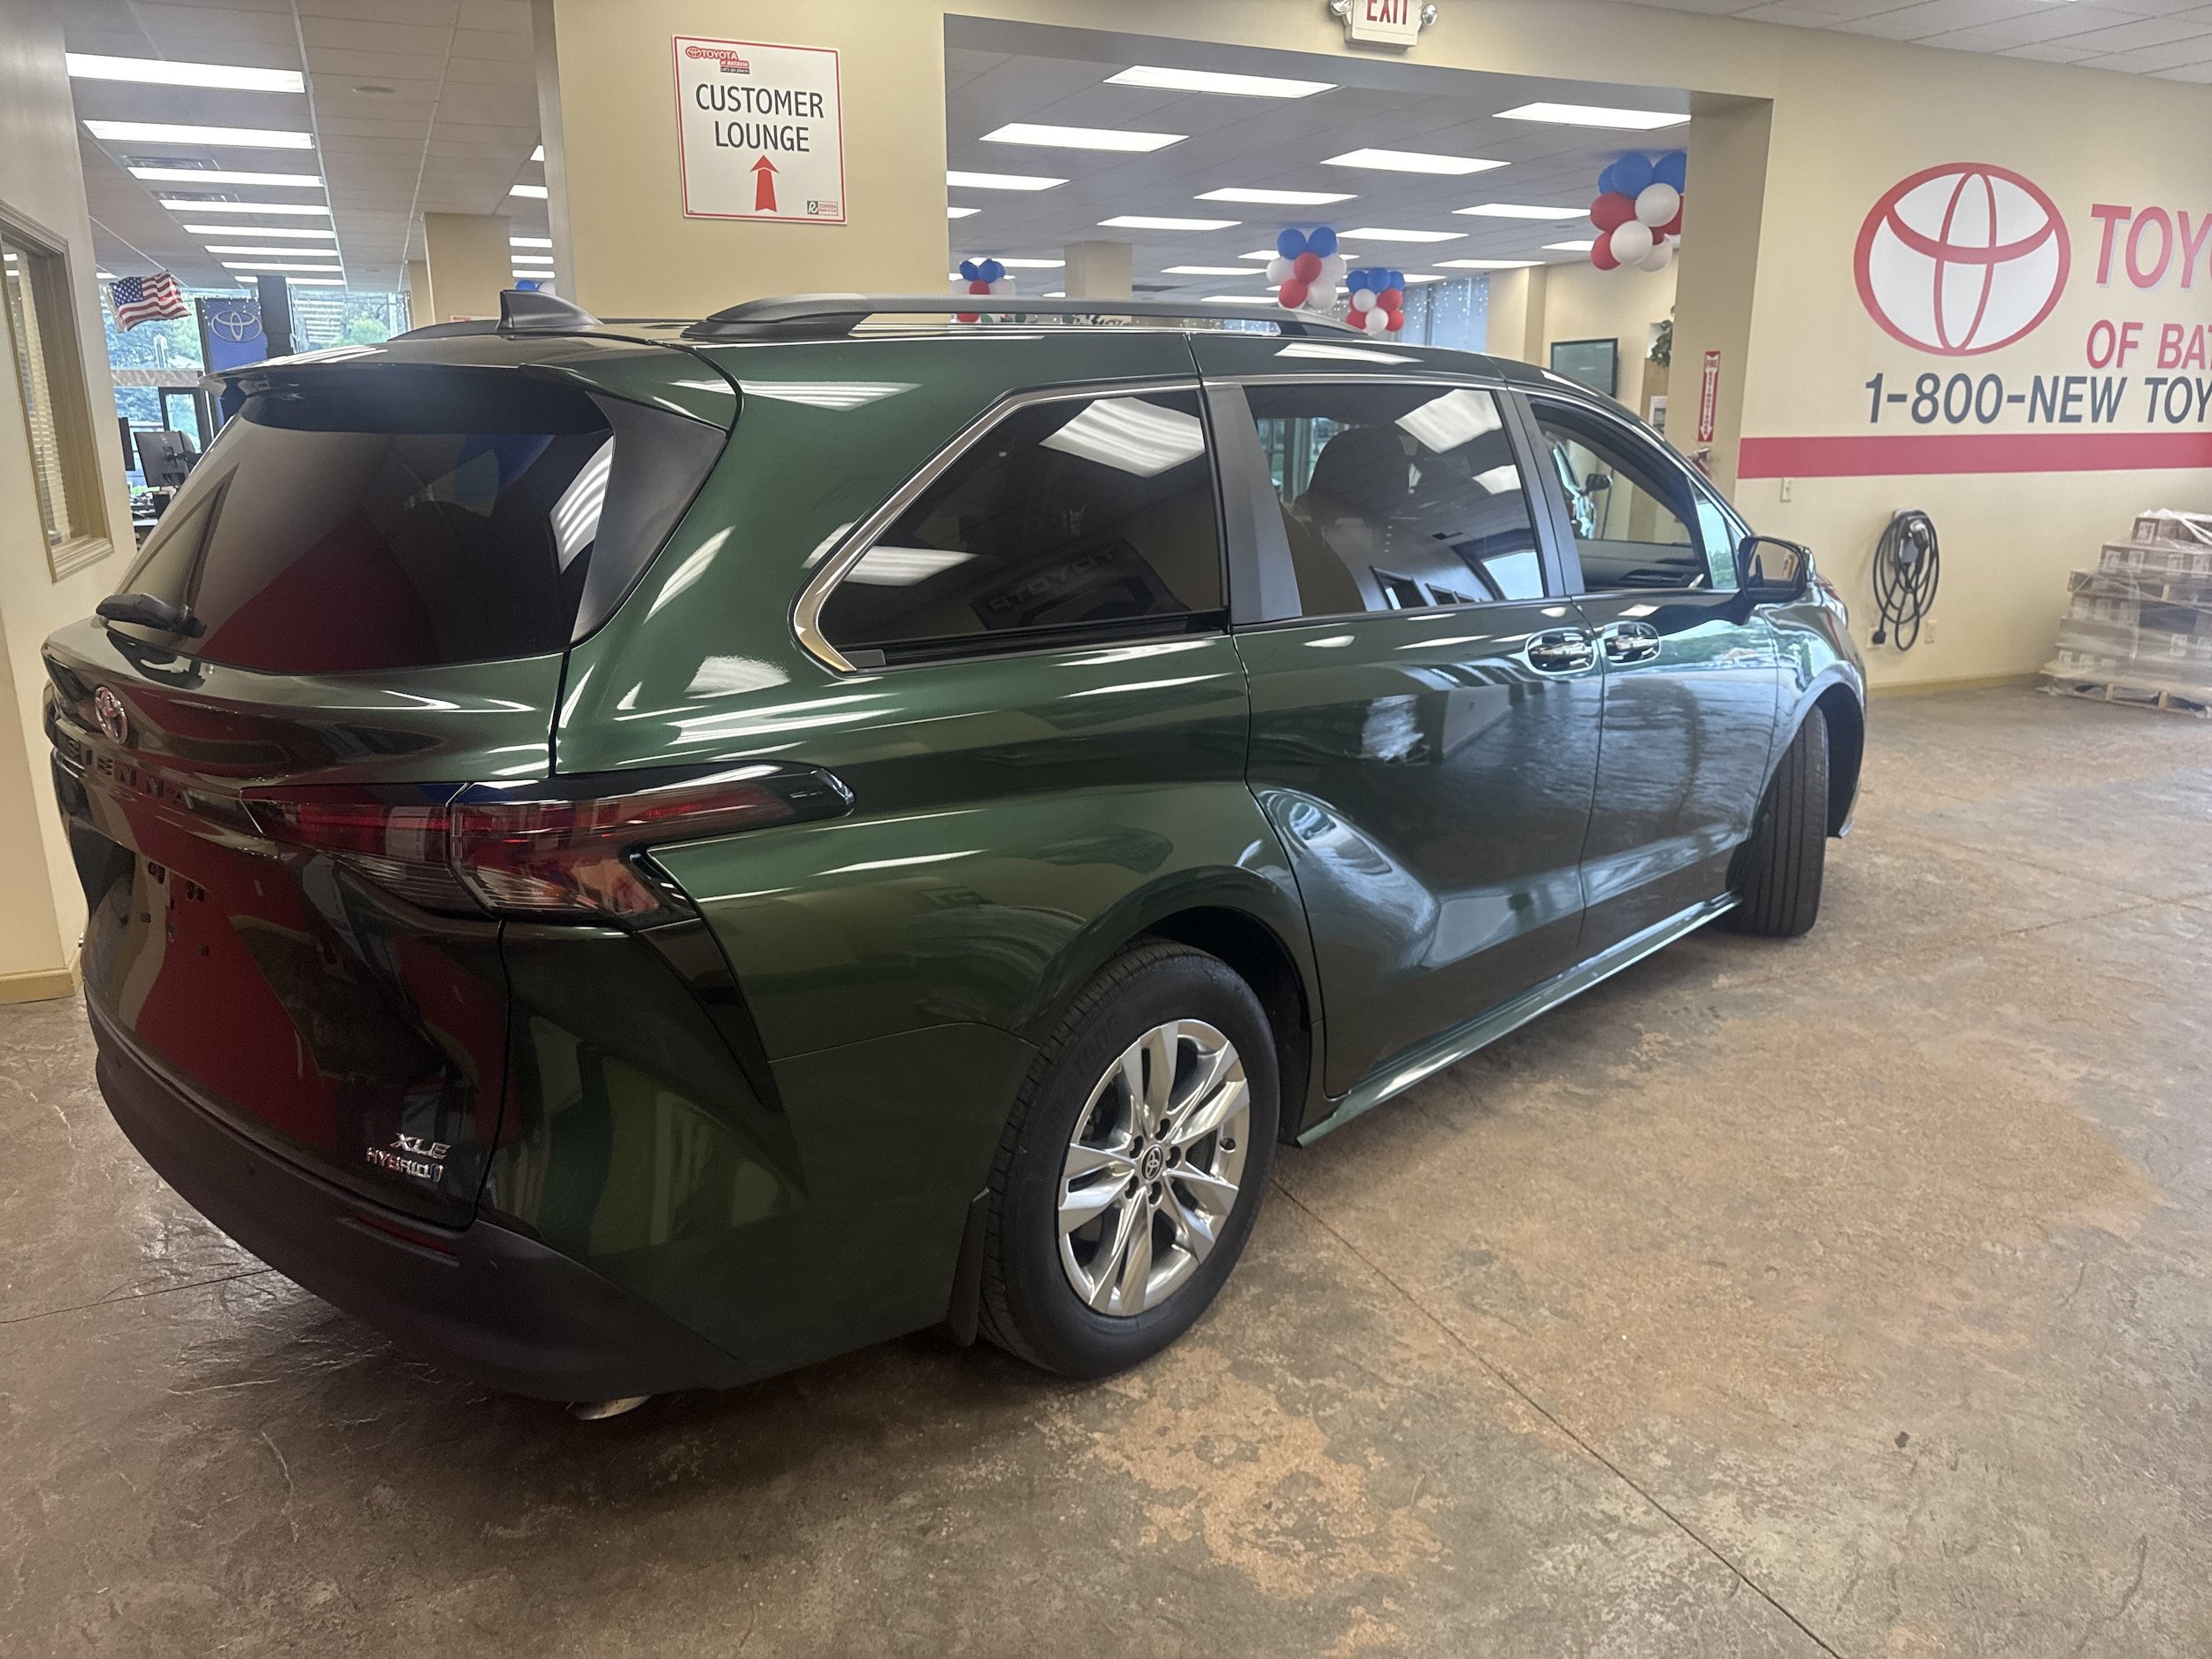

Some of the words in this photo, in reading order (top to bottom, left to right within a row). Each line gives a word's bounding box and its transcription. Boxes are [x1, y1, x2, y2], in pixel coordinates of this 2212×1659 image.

[700, 49, 738, 60] TOYOTA
[695, 83, 825, 119] CUSTOMER
[714, 120, 810, 152] LOUNGE
[2091, 204, 2212, 289] TOY
[2086, 319, 2144, 369] OF
[1706, 359, 1717, 368] FIRE
[1703, 371, 1713, 435] EXTINGUISHER
[1865, 373, 2128, 425] 1-800-NEW
[390, 1133, 450, 1159] XLE
[366, 1148, 431, 1179] HYBRID
